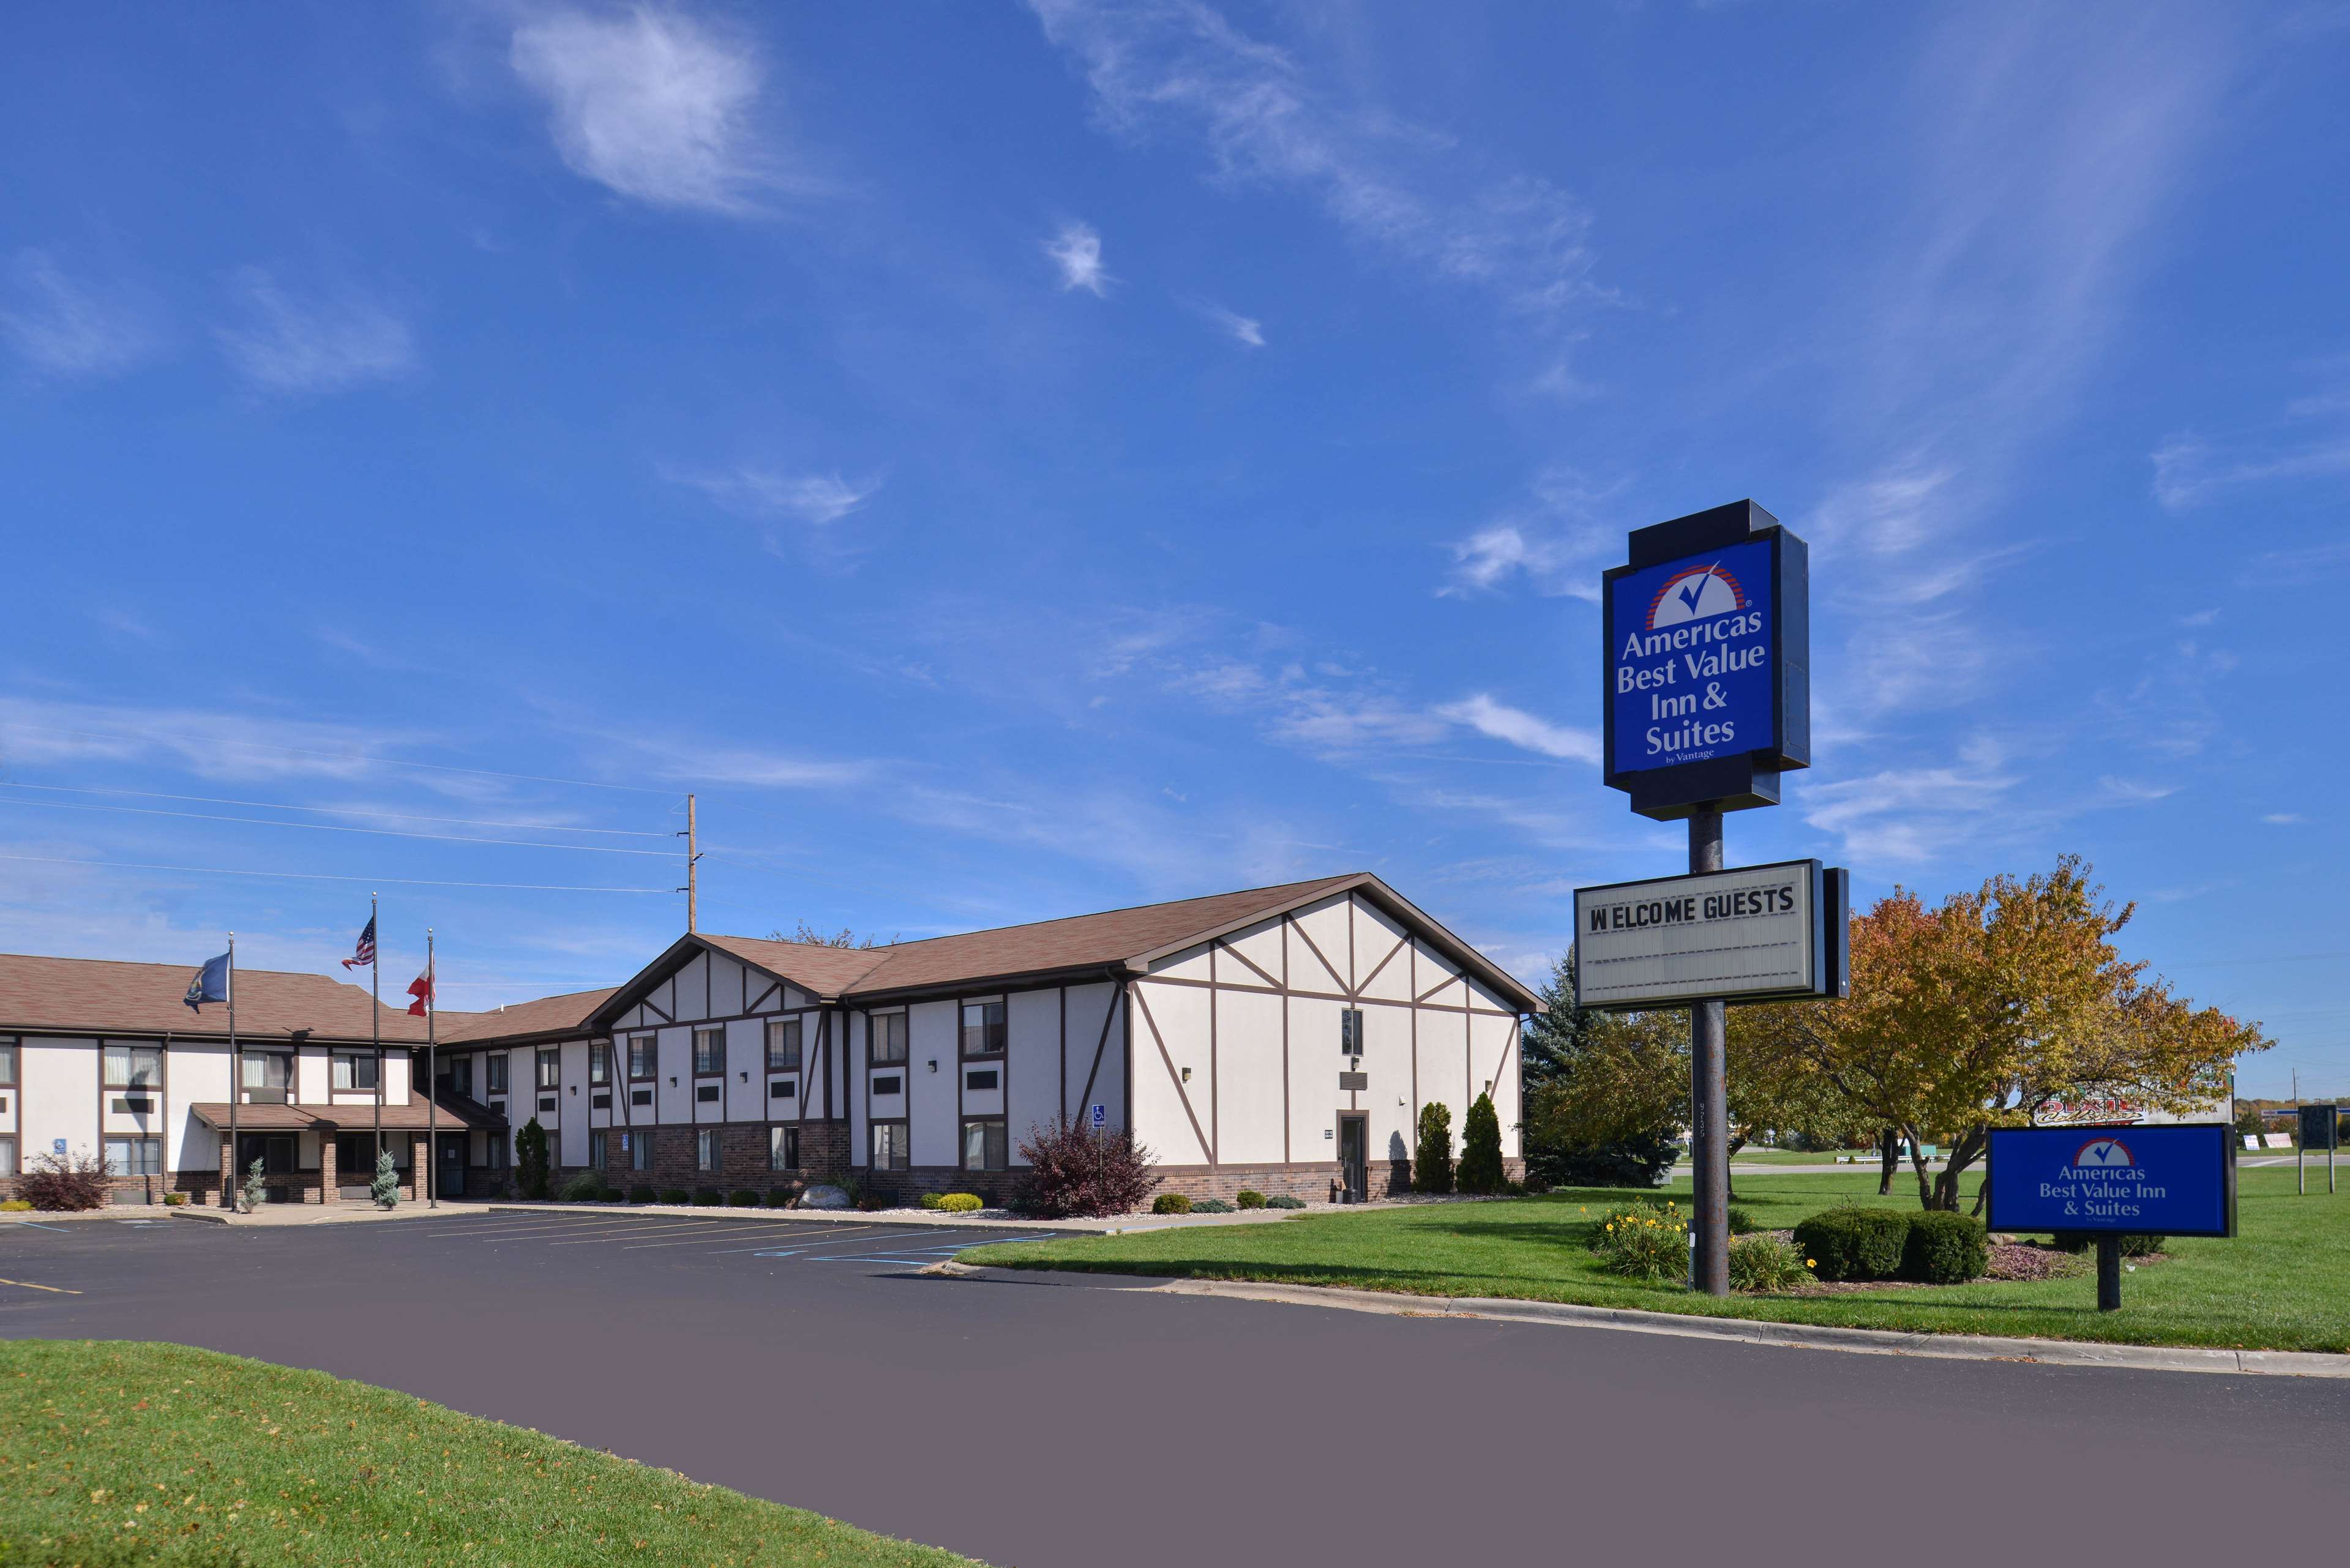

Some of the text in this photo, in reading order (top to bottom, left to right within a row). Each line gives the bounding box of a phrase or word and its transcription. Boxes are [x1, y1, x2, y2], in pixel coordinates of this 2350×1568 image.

[1622, 611, 1761, 660] Americas
[1618, 643, 1765, 693] Best Value
[1652, 682, 1727, 720] Inn &
[1647, 720, 1734, 755] Suites
[1676, 750, 1714, 760] Vantage
[1592, 887, 1794, 930] WELCOME GUESTS
[2040, 1182, 2166, 1198] Best Value Inn
[2059, 1165, 2145, 1180] Americas
[2064, 1200, 2140, 1216] & Suites
